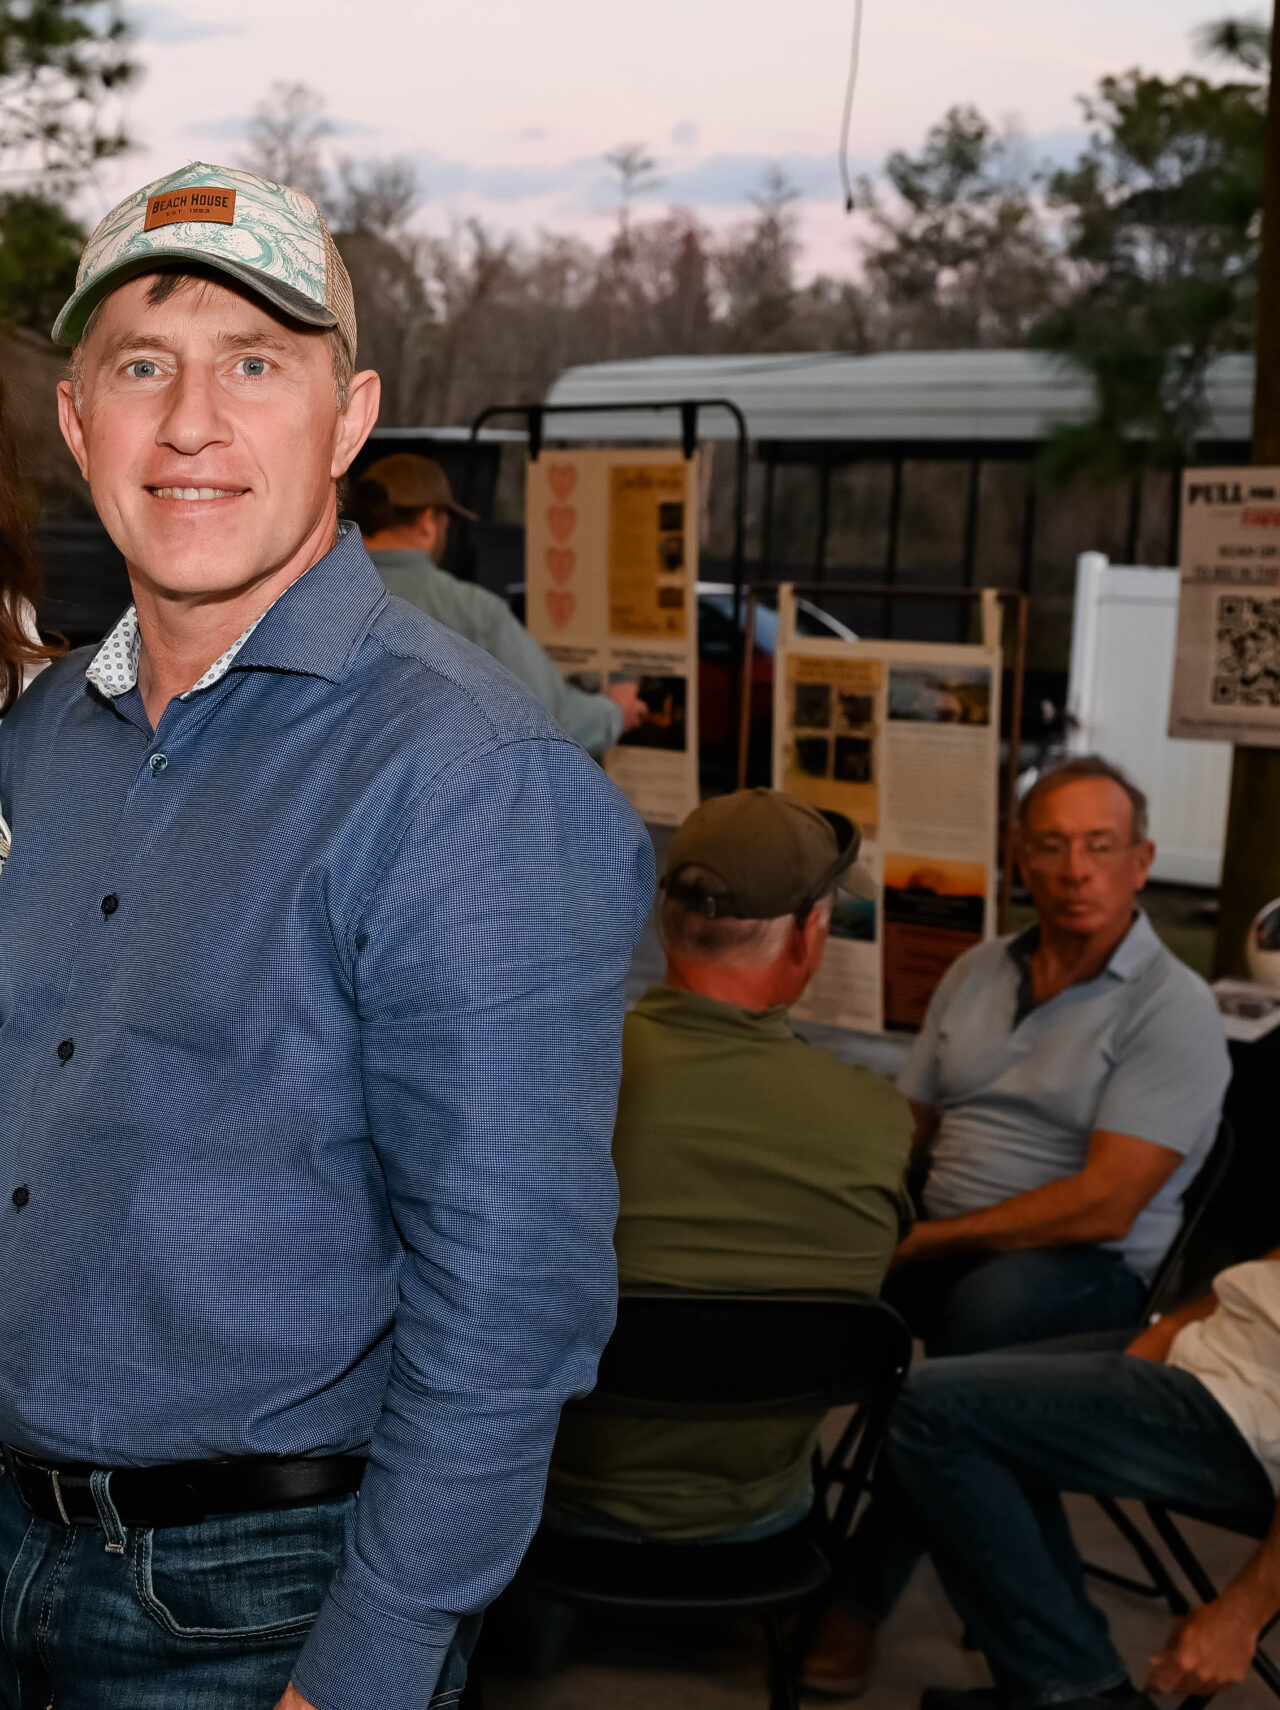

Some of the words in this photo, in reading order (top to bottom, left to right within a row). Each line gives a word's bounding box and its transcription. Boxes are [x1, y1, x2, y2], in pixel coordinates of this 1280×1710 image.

[152, 196, 187, 213] BEACH
[191, 194, 229, 208] HOUSE
[1188, 482, 1242, 505] PULL
